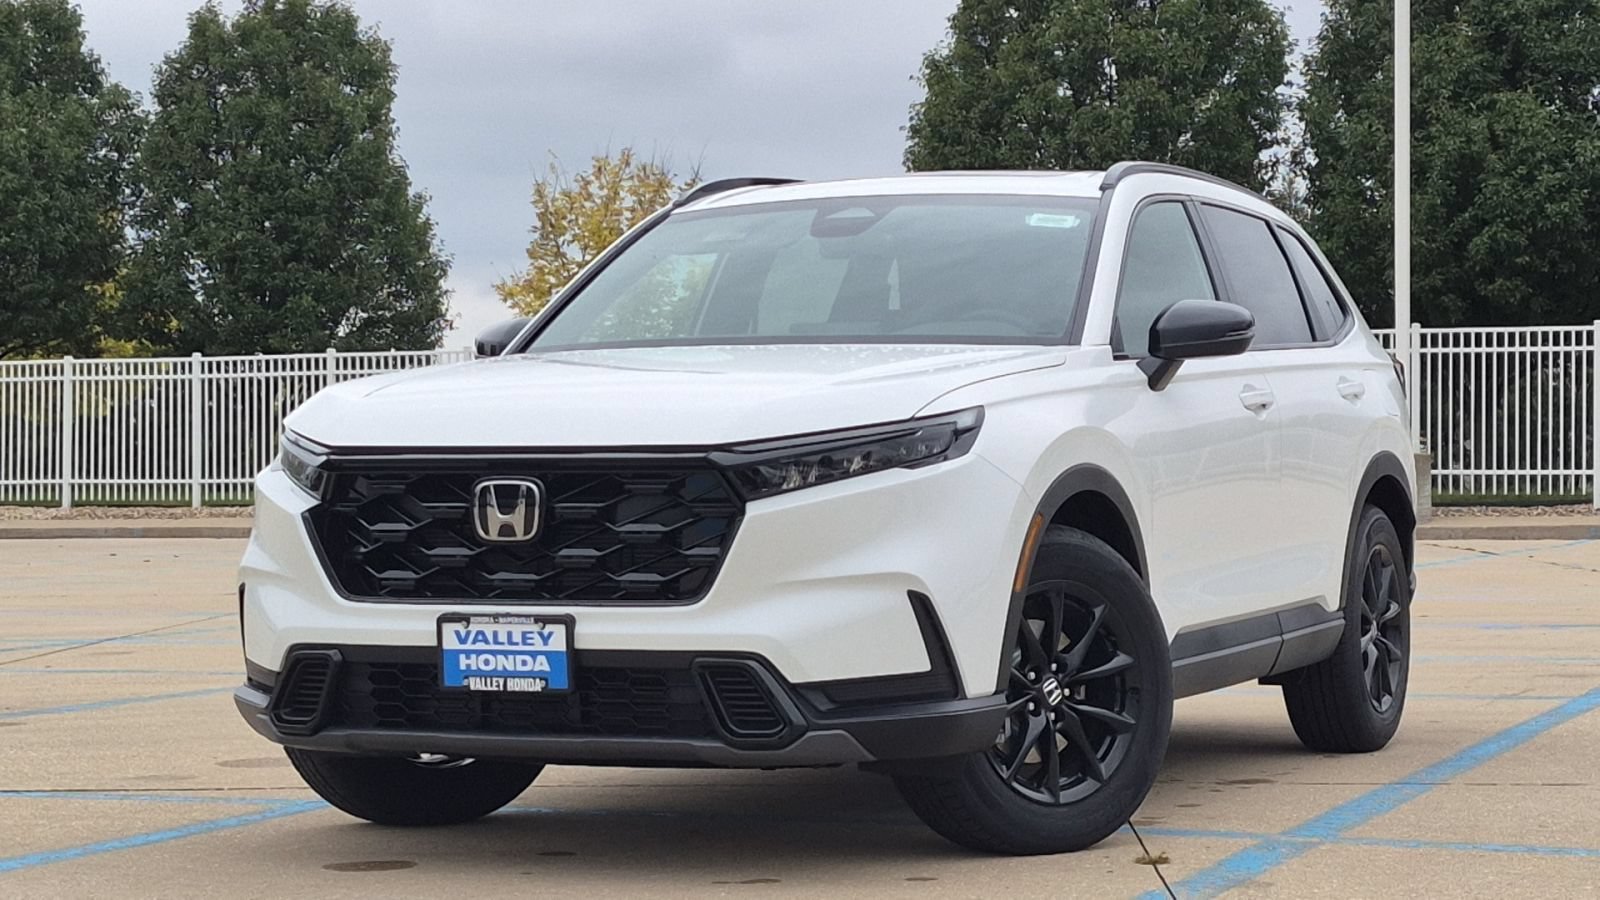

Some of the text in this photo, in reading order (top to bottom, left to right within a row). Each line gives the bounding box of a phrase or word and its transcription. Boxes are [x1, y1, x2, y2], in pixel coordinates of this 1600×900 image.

[454, 630, 554, 646] VALLEY
[459, 654, 551, 672] HONDA
[469, 677, 542, 692] VALLEY HONDA
